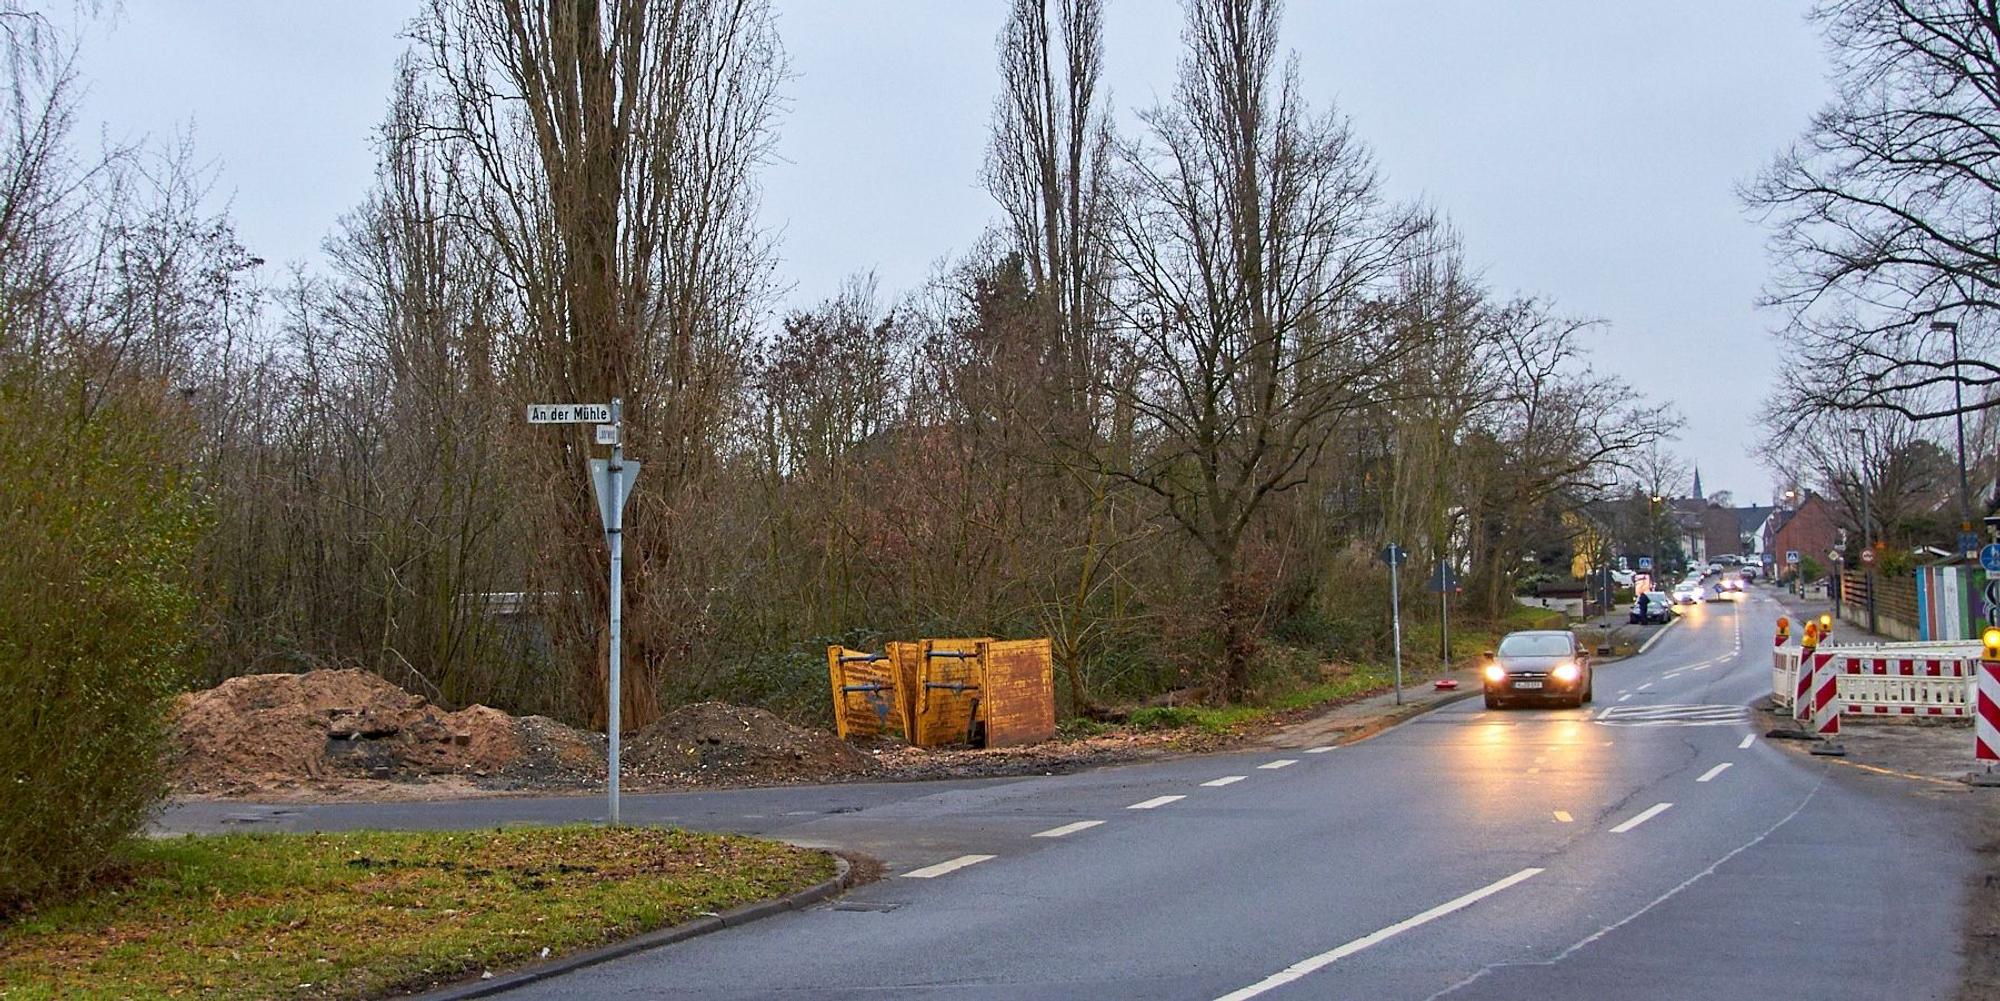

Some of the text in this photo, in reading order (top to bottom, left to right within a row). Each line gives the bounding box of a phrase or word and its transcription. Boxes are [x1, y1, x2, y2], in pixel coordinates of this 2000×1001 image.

[532, 407, 607, 421] An der Mühle
